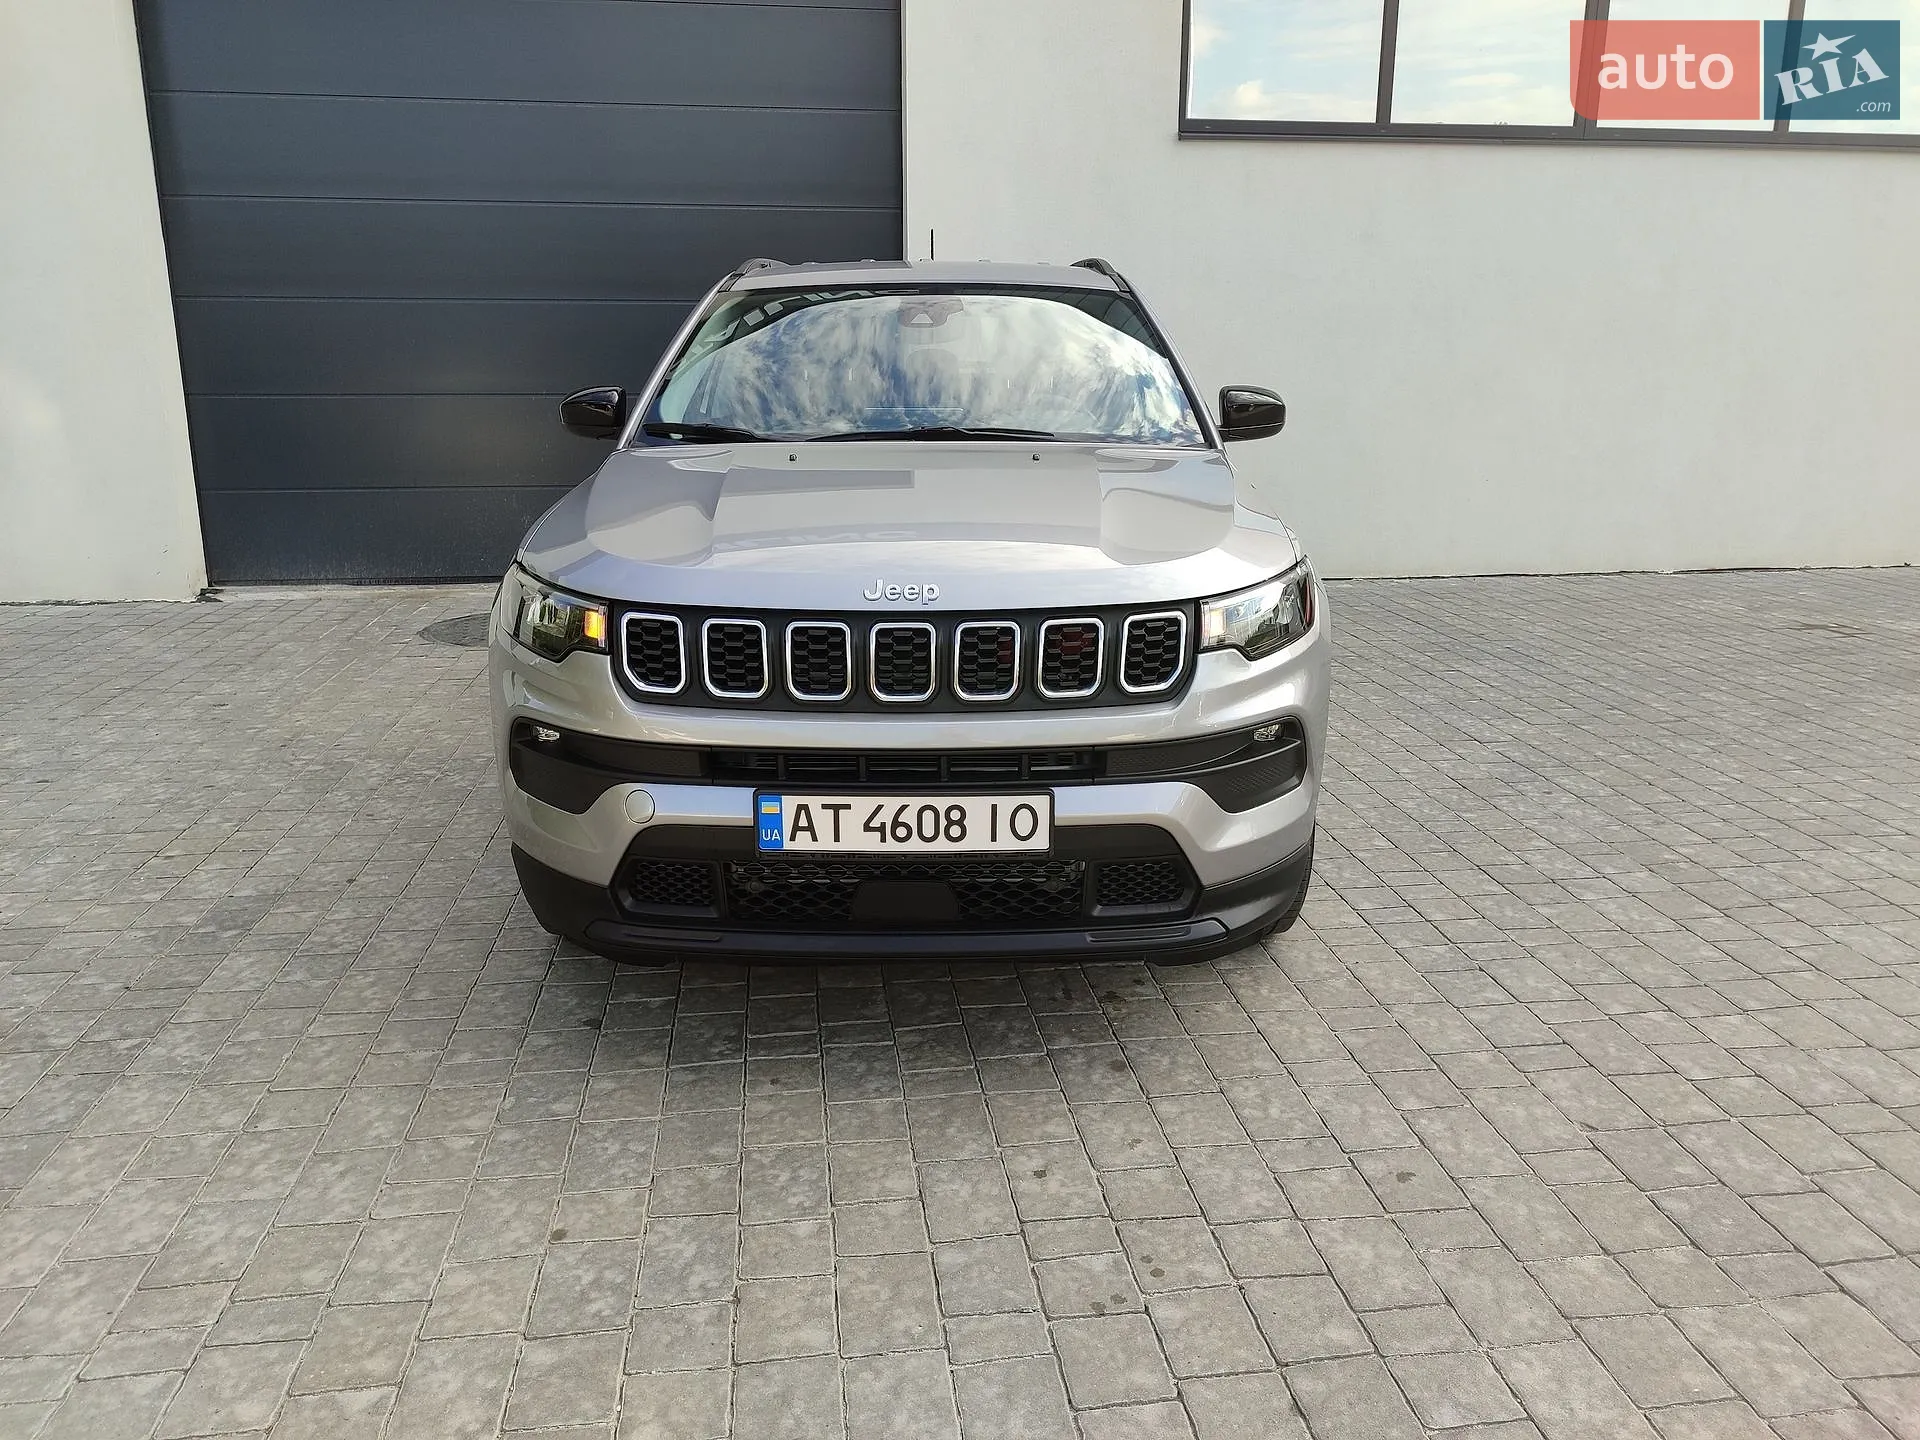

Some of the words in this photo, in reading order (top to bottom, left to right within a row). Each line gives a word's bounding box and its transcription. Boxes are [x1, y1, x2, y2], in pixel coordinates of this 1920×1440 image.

[863, 579, 940, 605] Jeep
[761, 828, 781, 841] UA
[789, 803, 851, 843] AT
[862, 804, 967, 843] 4608
[990, 803, 1039, 842] IO
